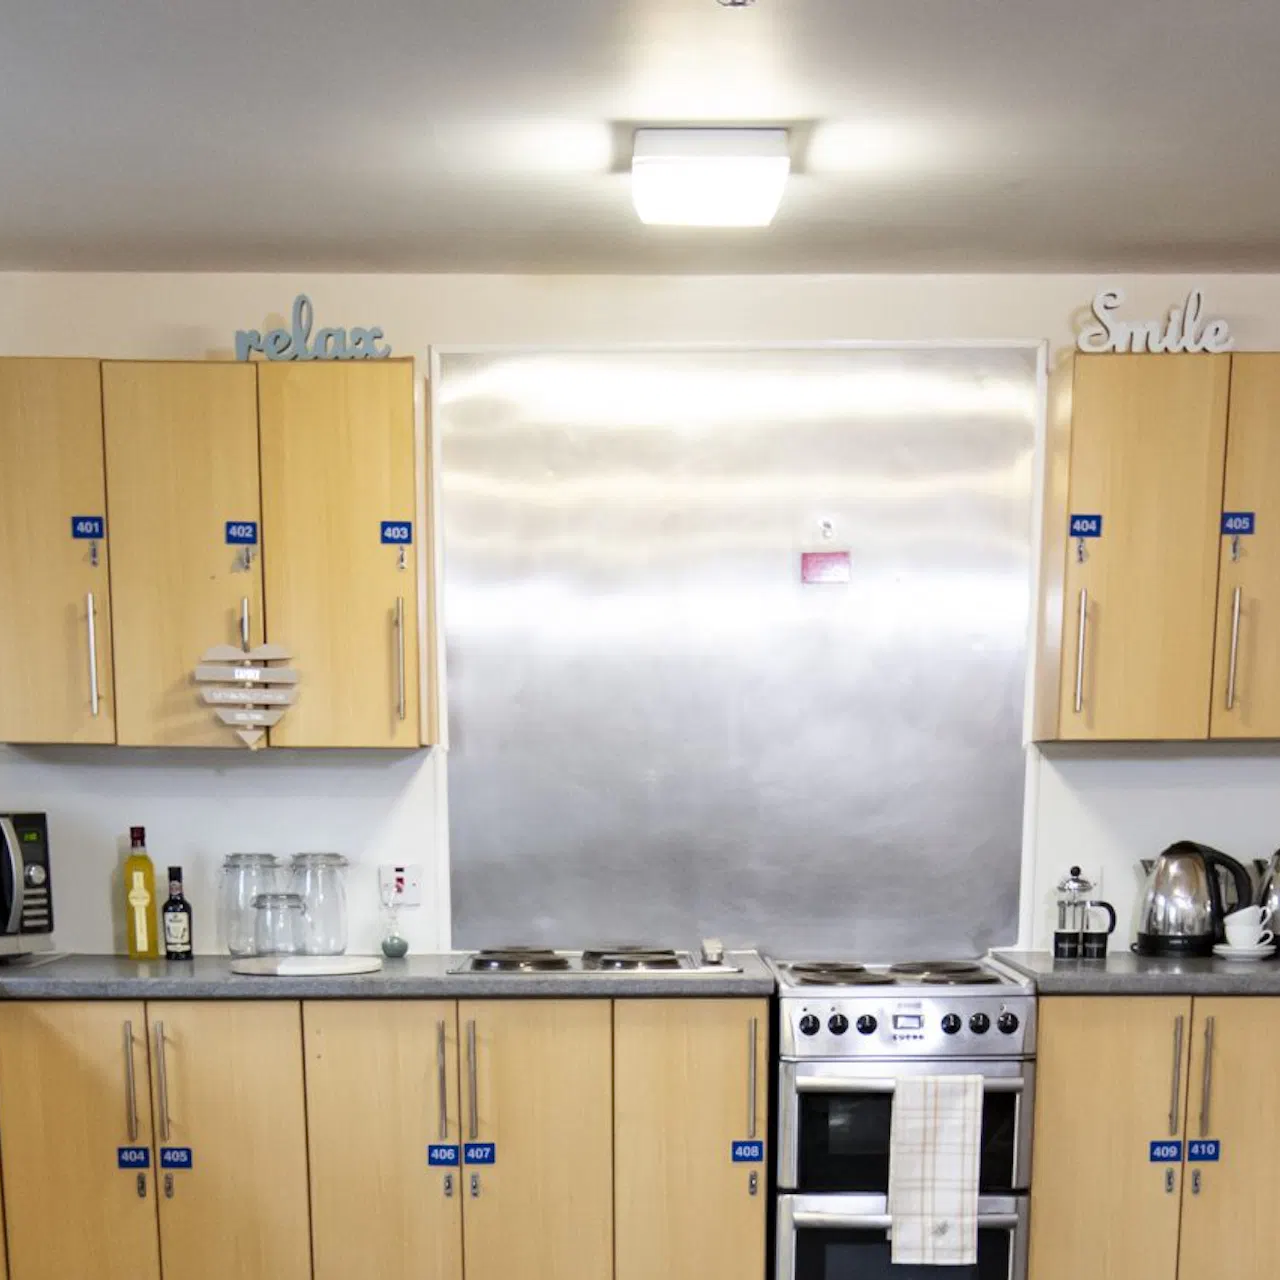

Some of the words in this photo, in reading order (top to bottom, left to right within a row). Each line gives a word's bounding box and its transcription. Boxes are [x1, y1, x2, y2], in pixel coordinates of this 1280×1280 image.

[1077, 286, 1235, 353] Smile
[235, 293, 393, 361] relax
[76, 521, 100, 534] 401
[1072, 519, 1097, 532] 404
[1225, 517, 1250, 530] 405
[228, 525, 254, 538] 402
[383, 527, 409, 540] 403
[120, 1150, 145, 1162] 404
[430, 1148, 455, 1161] 406
[466, 1147, 492, 1159] 407
[735, 1145, 760, 1158] 408
[1152, 1145, 1178, 1158] 409
[1190, 1143, 1216, 1156] 410
[163, 1150, 188, 1163] 405
